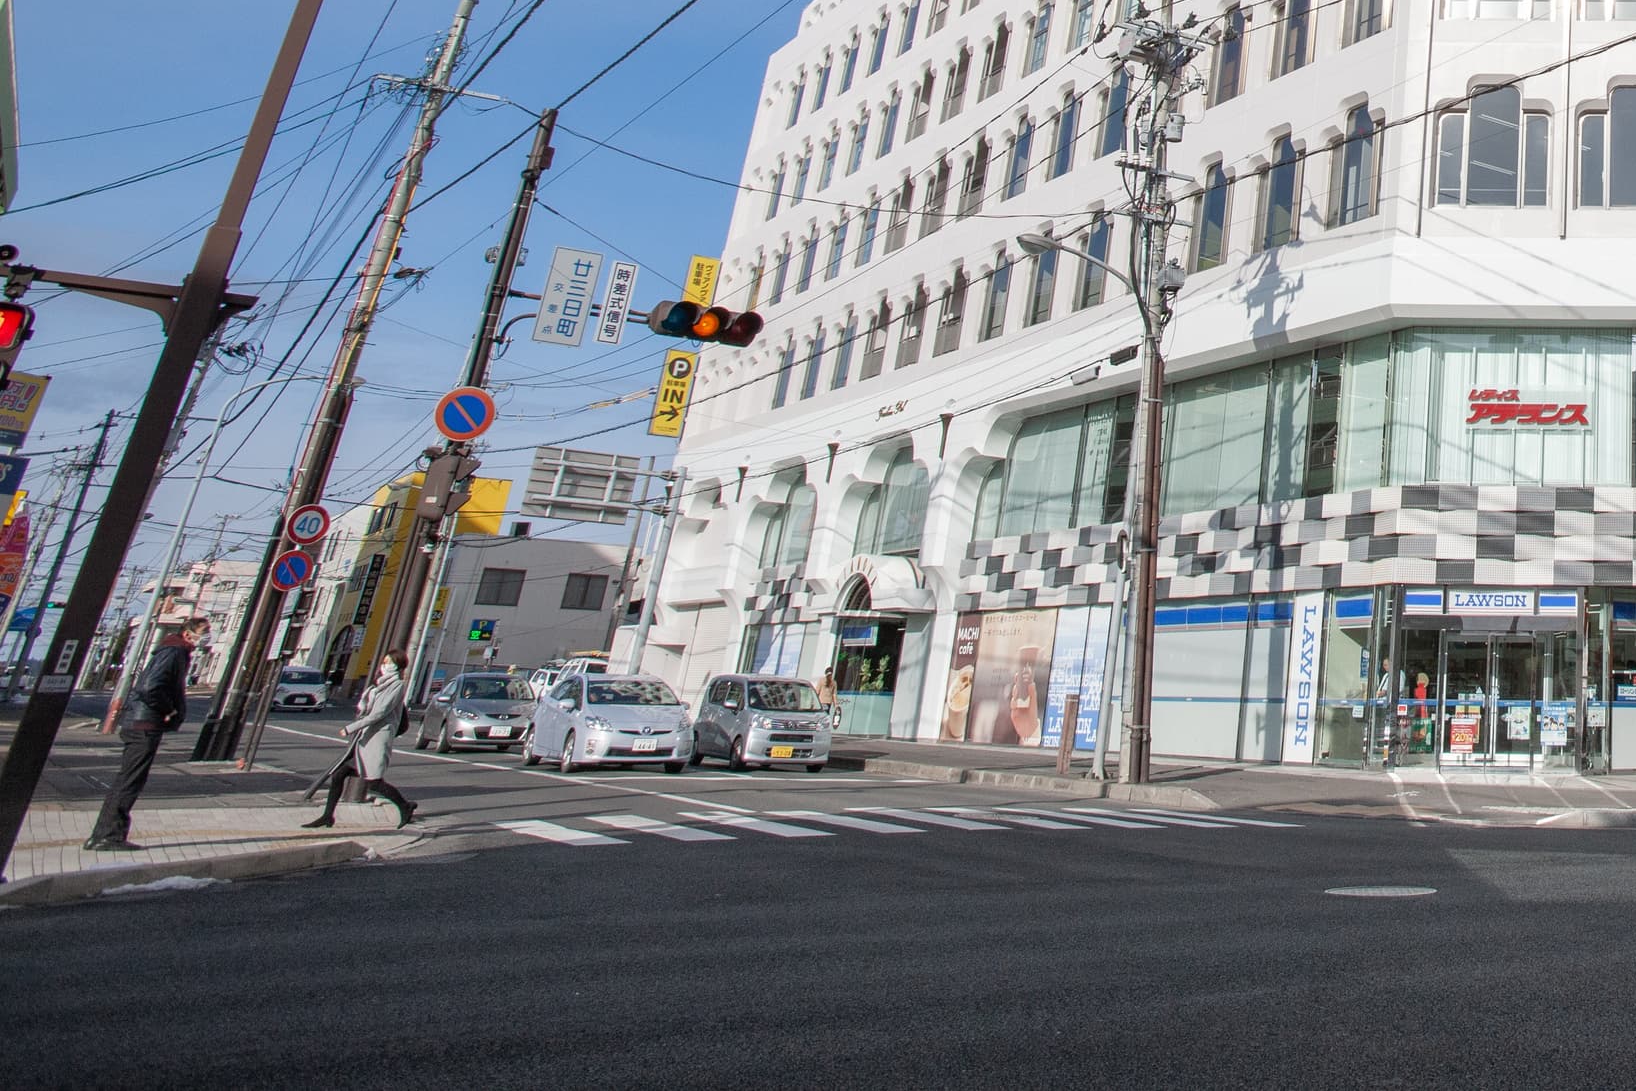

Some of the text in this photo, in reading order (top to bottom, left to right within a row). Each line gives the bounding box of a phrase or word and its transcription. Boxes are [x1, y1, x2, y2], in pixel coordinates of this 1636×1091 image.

[556, 259, 593, 337] 廿三日町
[603, 268, 631, 338] 時差式信号
[672, 361, 689, 378] P
[662, 388, 684, 404] IN
[296, 517, 321, 535] 40
[1455, 594, 1527, 607] LAWSON
[957, 627, 980, 641] MACHI
[959, 641, 974, 655] café
[1294, 606, 1317, 746] LAWSON
